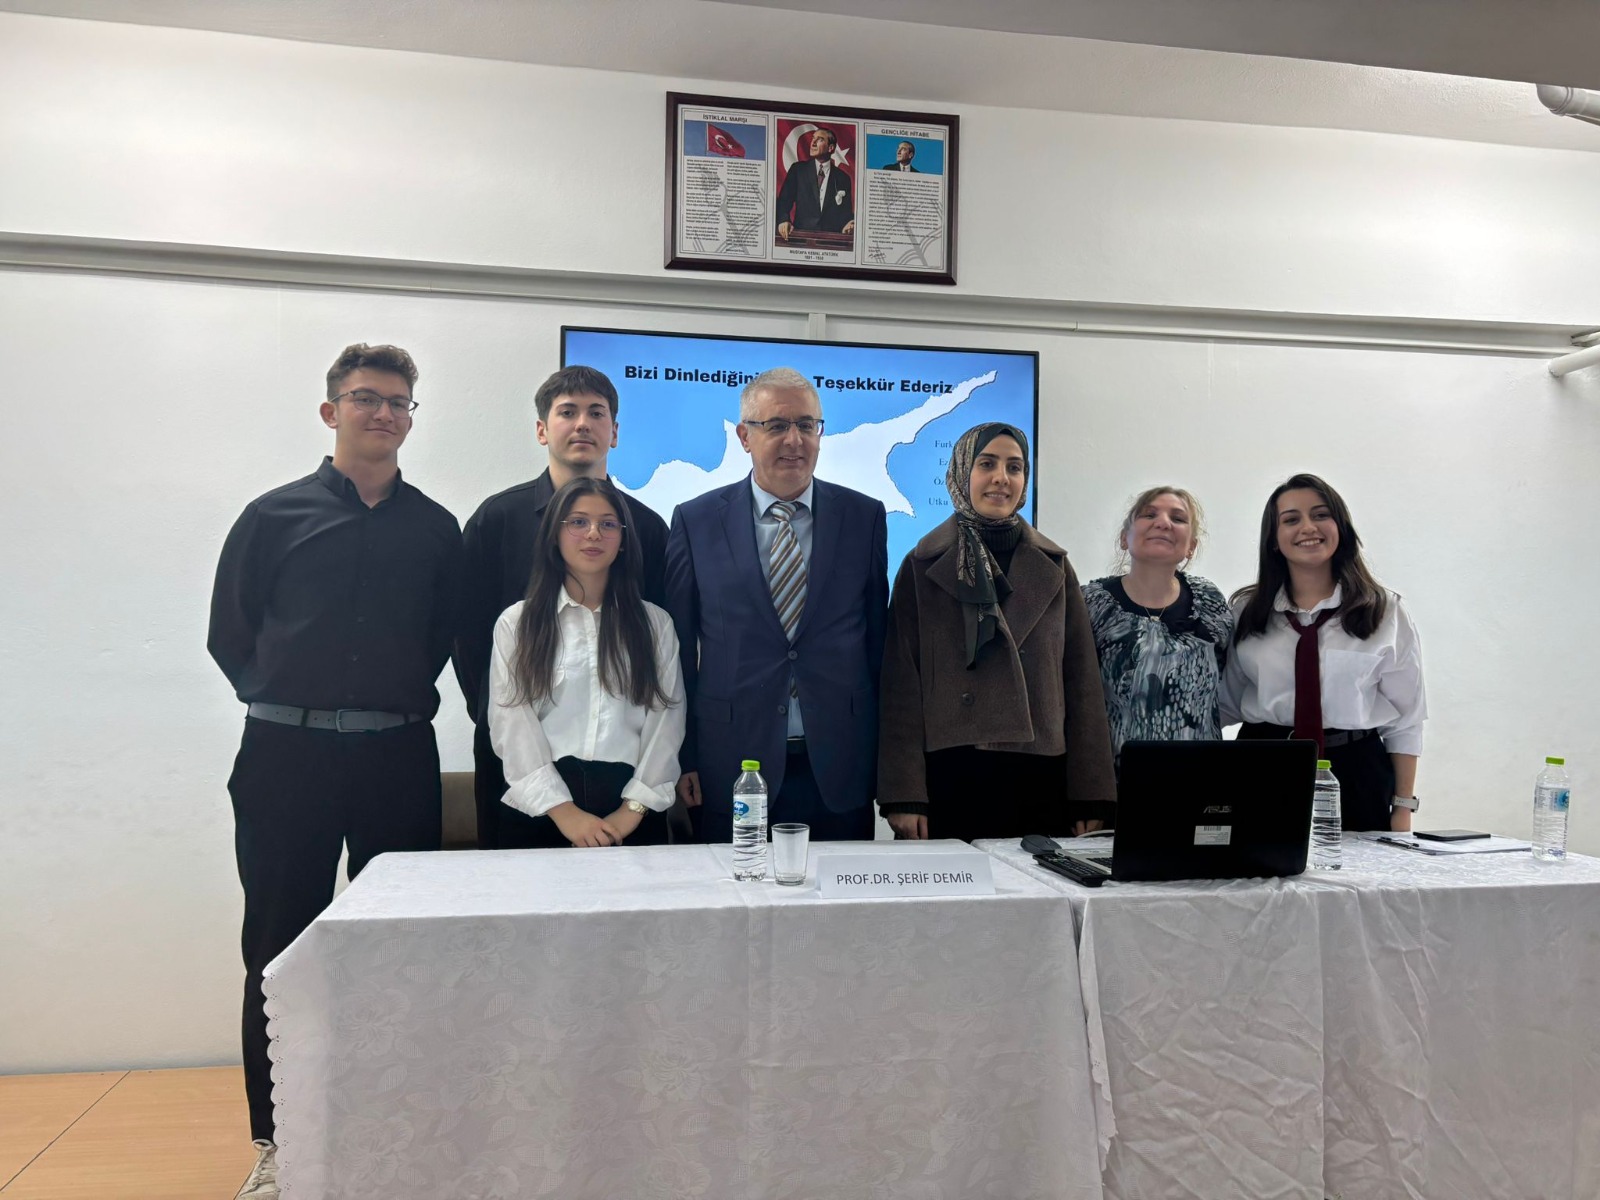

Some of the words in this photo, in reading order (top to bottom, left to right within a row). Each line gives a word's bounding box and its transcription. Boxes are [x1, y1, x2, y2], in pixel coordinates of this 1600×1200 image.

[625, 366, 658, 379] Bizi
[813, 375, 895, 392] Teşekkür
[901, 379, 953, 394] Ederiz
[928, 498, 949, 506] Utku
[1203, 805, 1232, 814] ASUS
[897, 871, 930, 886] ŞERİF
[933, 870, 974, 884] DEMİR
